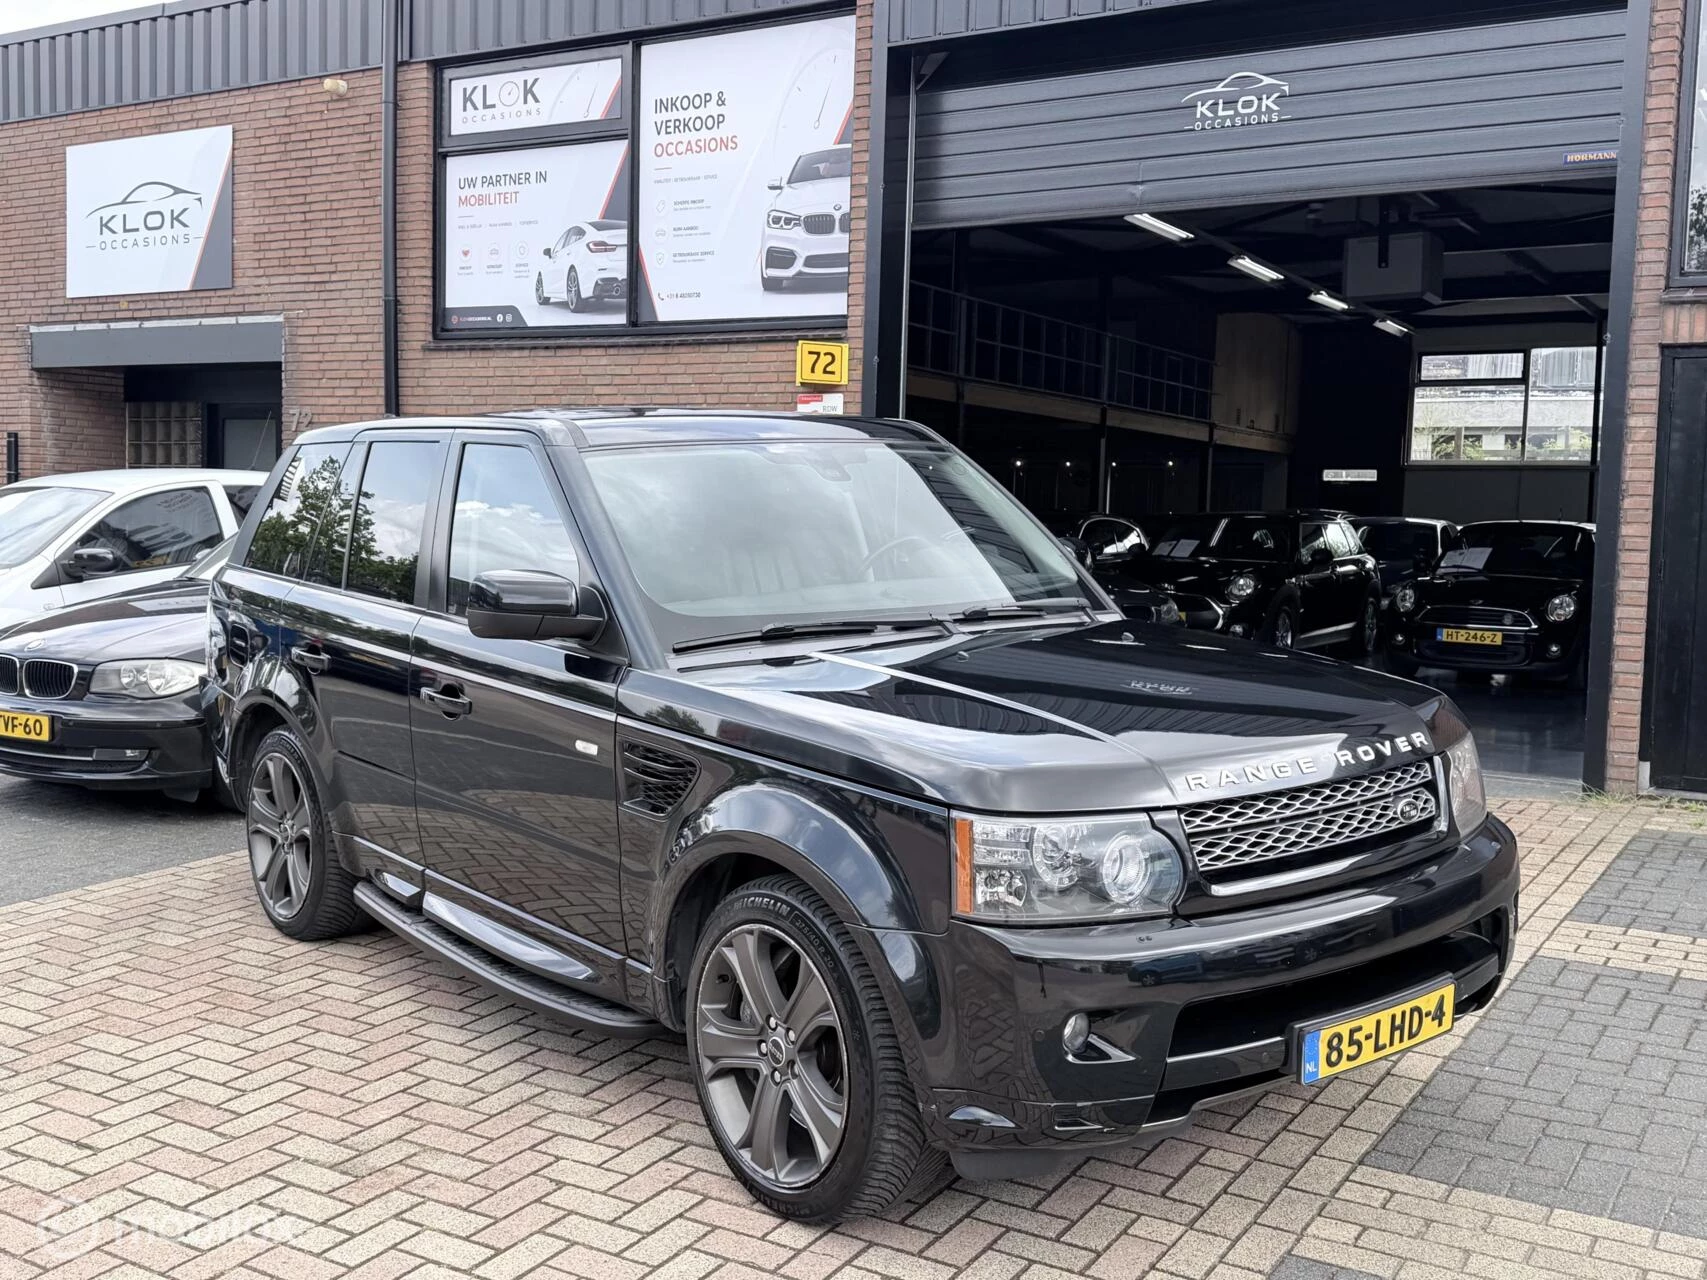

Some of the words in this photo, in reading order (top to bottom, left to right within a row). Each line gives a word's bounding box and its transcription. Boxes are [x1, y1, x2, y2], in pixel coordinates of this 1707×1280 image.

[462, 77, 540, 113] KLOK
[654, 92, 712, 114] INKOOP
[716, 90, 726, 107] &
[1196, 92, 1281, 118] KLOK
[462, 108, 541, 124] OCCASIONS
[654, 113, 725, 136] VERKOOP
[1194, 112, 1279, 131] OCCASIONS
[654, 135, 738, 158] OCCASIONS
[458, 176, 477, 190] UW
[481, 172, 531, 188] PARTNER
[535, 170, 548, 184] IN
[458, 191, 520, 208] MOBILITEIT
[99, 207, 190, 236] KLOK
[99, 233, 191, 251] OCCASIONS
[807, 350, 836, 375] 72
[1446, 630, 1498, 643] HT-246-Z
[0, 715, 43, 736] VF-60
[1184, 757, 1318, 791] RANGE
[1333, 731, 1429, 767] ROVER
[734, 896, 791, 917] MICHELIN
[1325, 994, 1446, 1069] 85-LHD-4
[1305, 1061, 1318, 1073] NL
